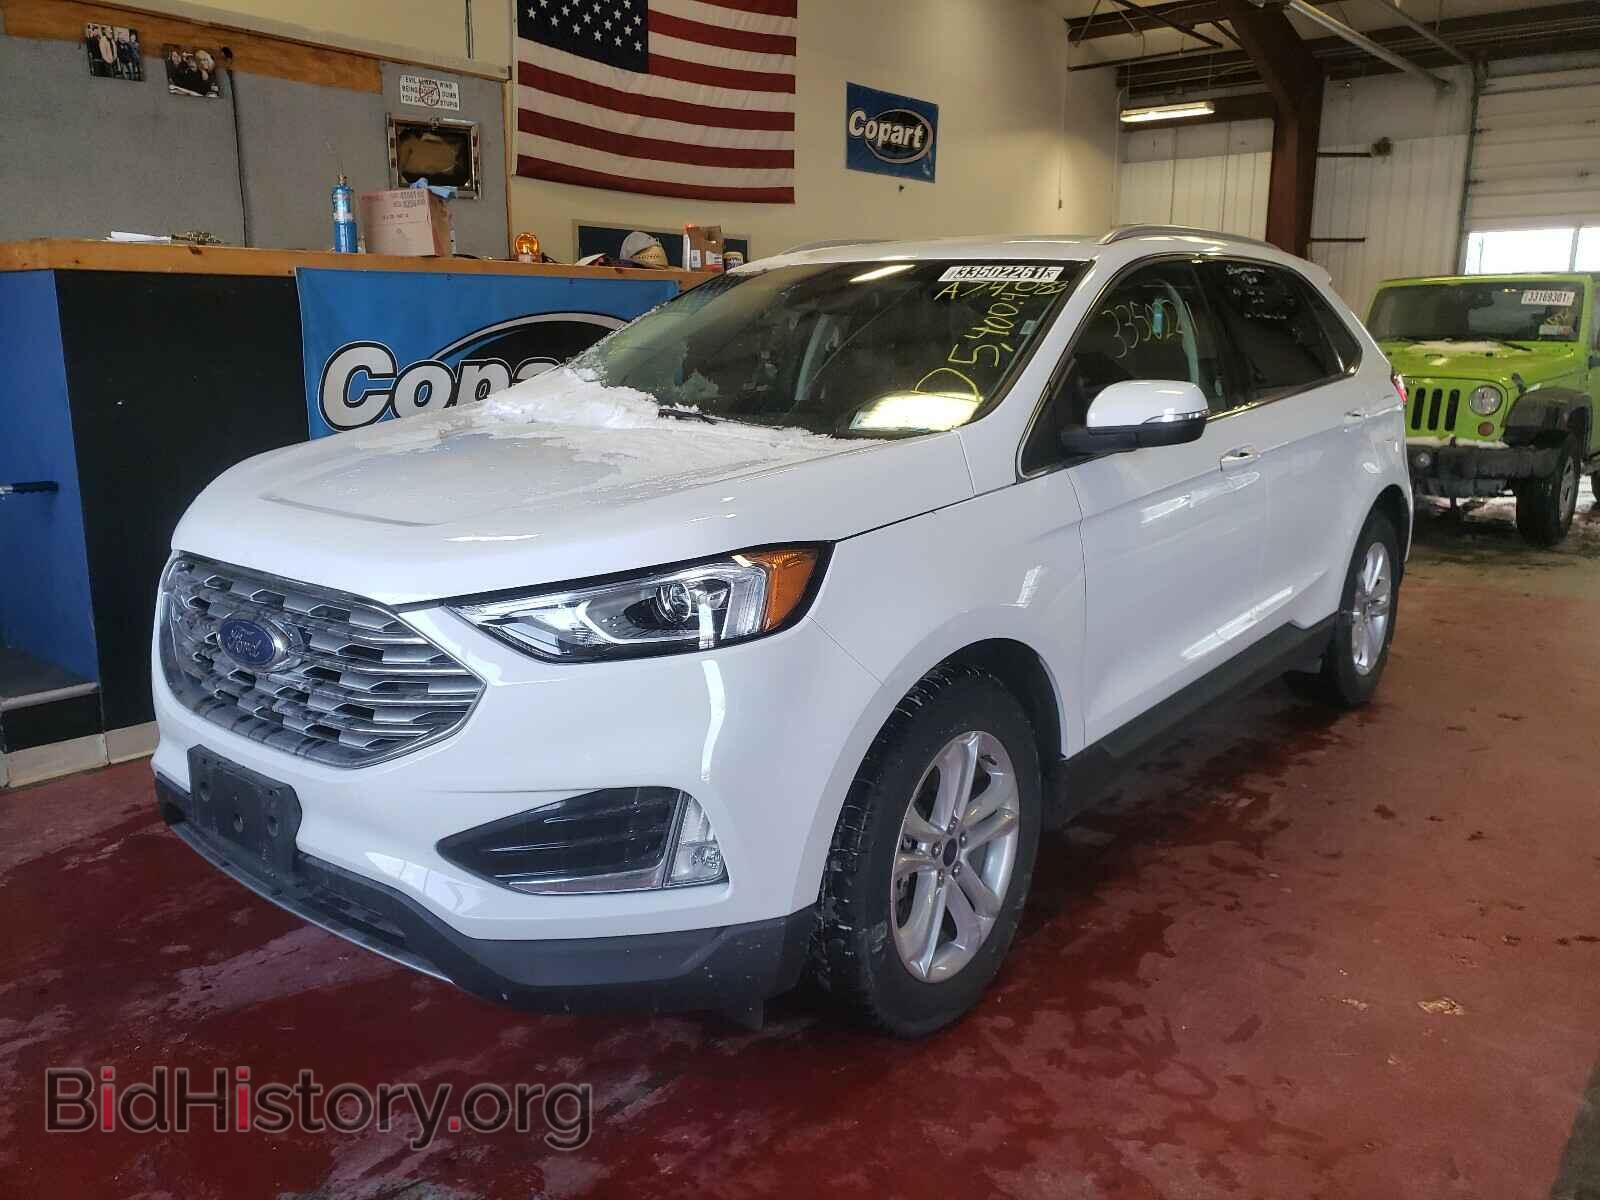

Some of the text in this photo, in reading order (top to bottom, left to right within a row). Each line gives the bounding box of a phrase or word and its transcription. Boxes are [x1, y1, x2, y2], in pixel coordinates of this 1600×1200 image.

[848, 109, 924, 148] Copart
[954, 266, 1047, 279] 33502261
[318, 341, 562, 432] Cop
